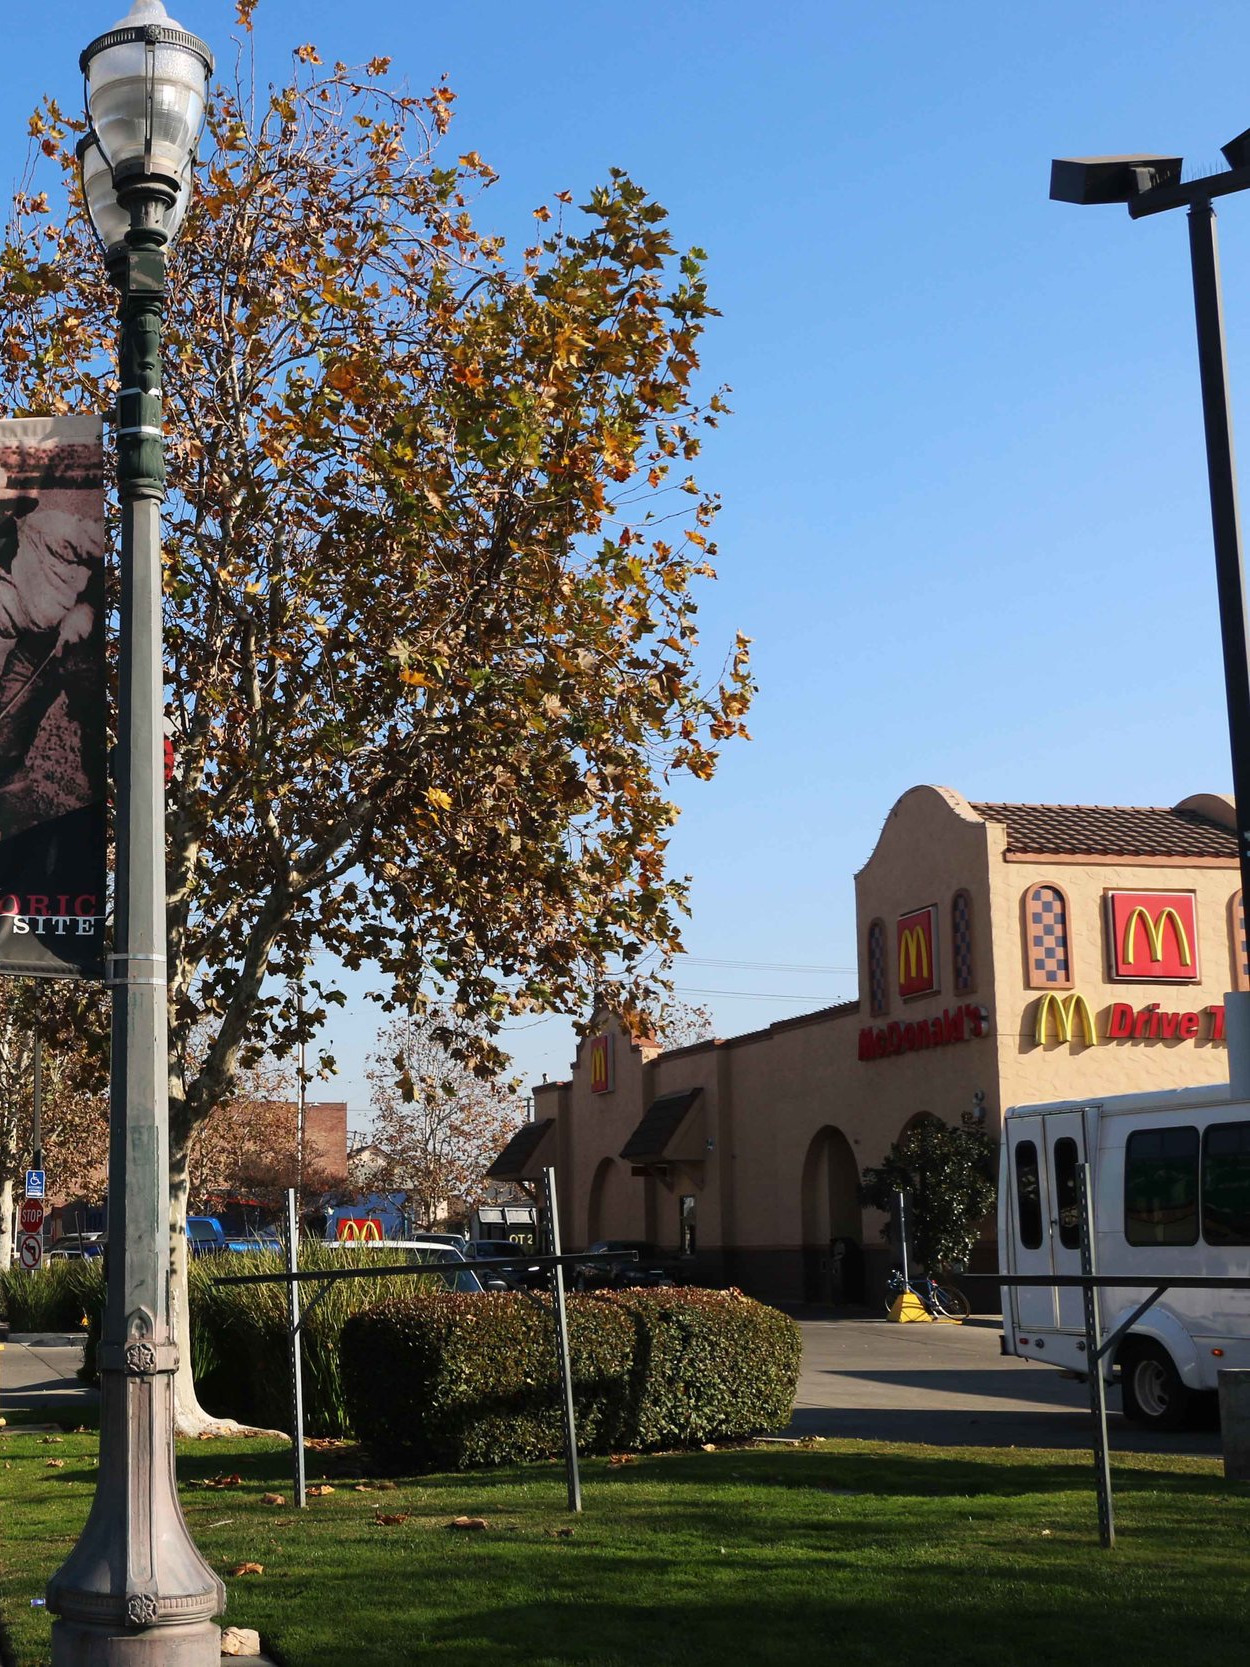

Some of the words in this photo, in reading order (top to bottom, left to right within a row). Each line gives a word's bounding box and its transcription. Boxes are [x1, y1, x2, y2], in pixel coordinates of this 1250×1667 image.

[13, 916, 95, 935] SITE
[858, 1003, 990, 1062] McDonald's
[1107, 1002, 1200, 1039] Drive
[22, 1209, 42, 1223] STOP
